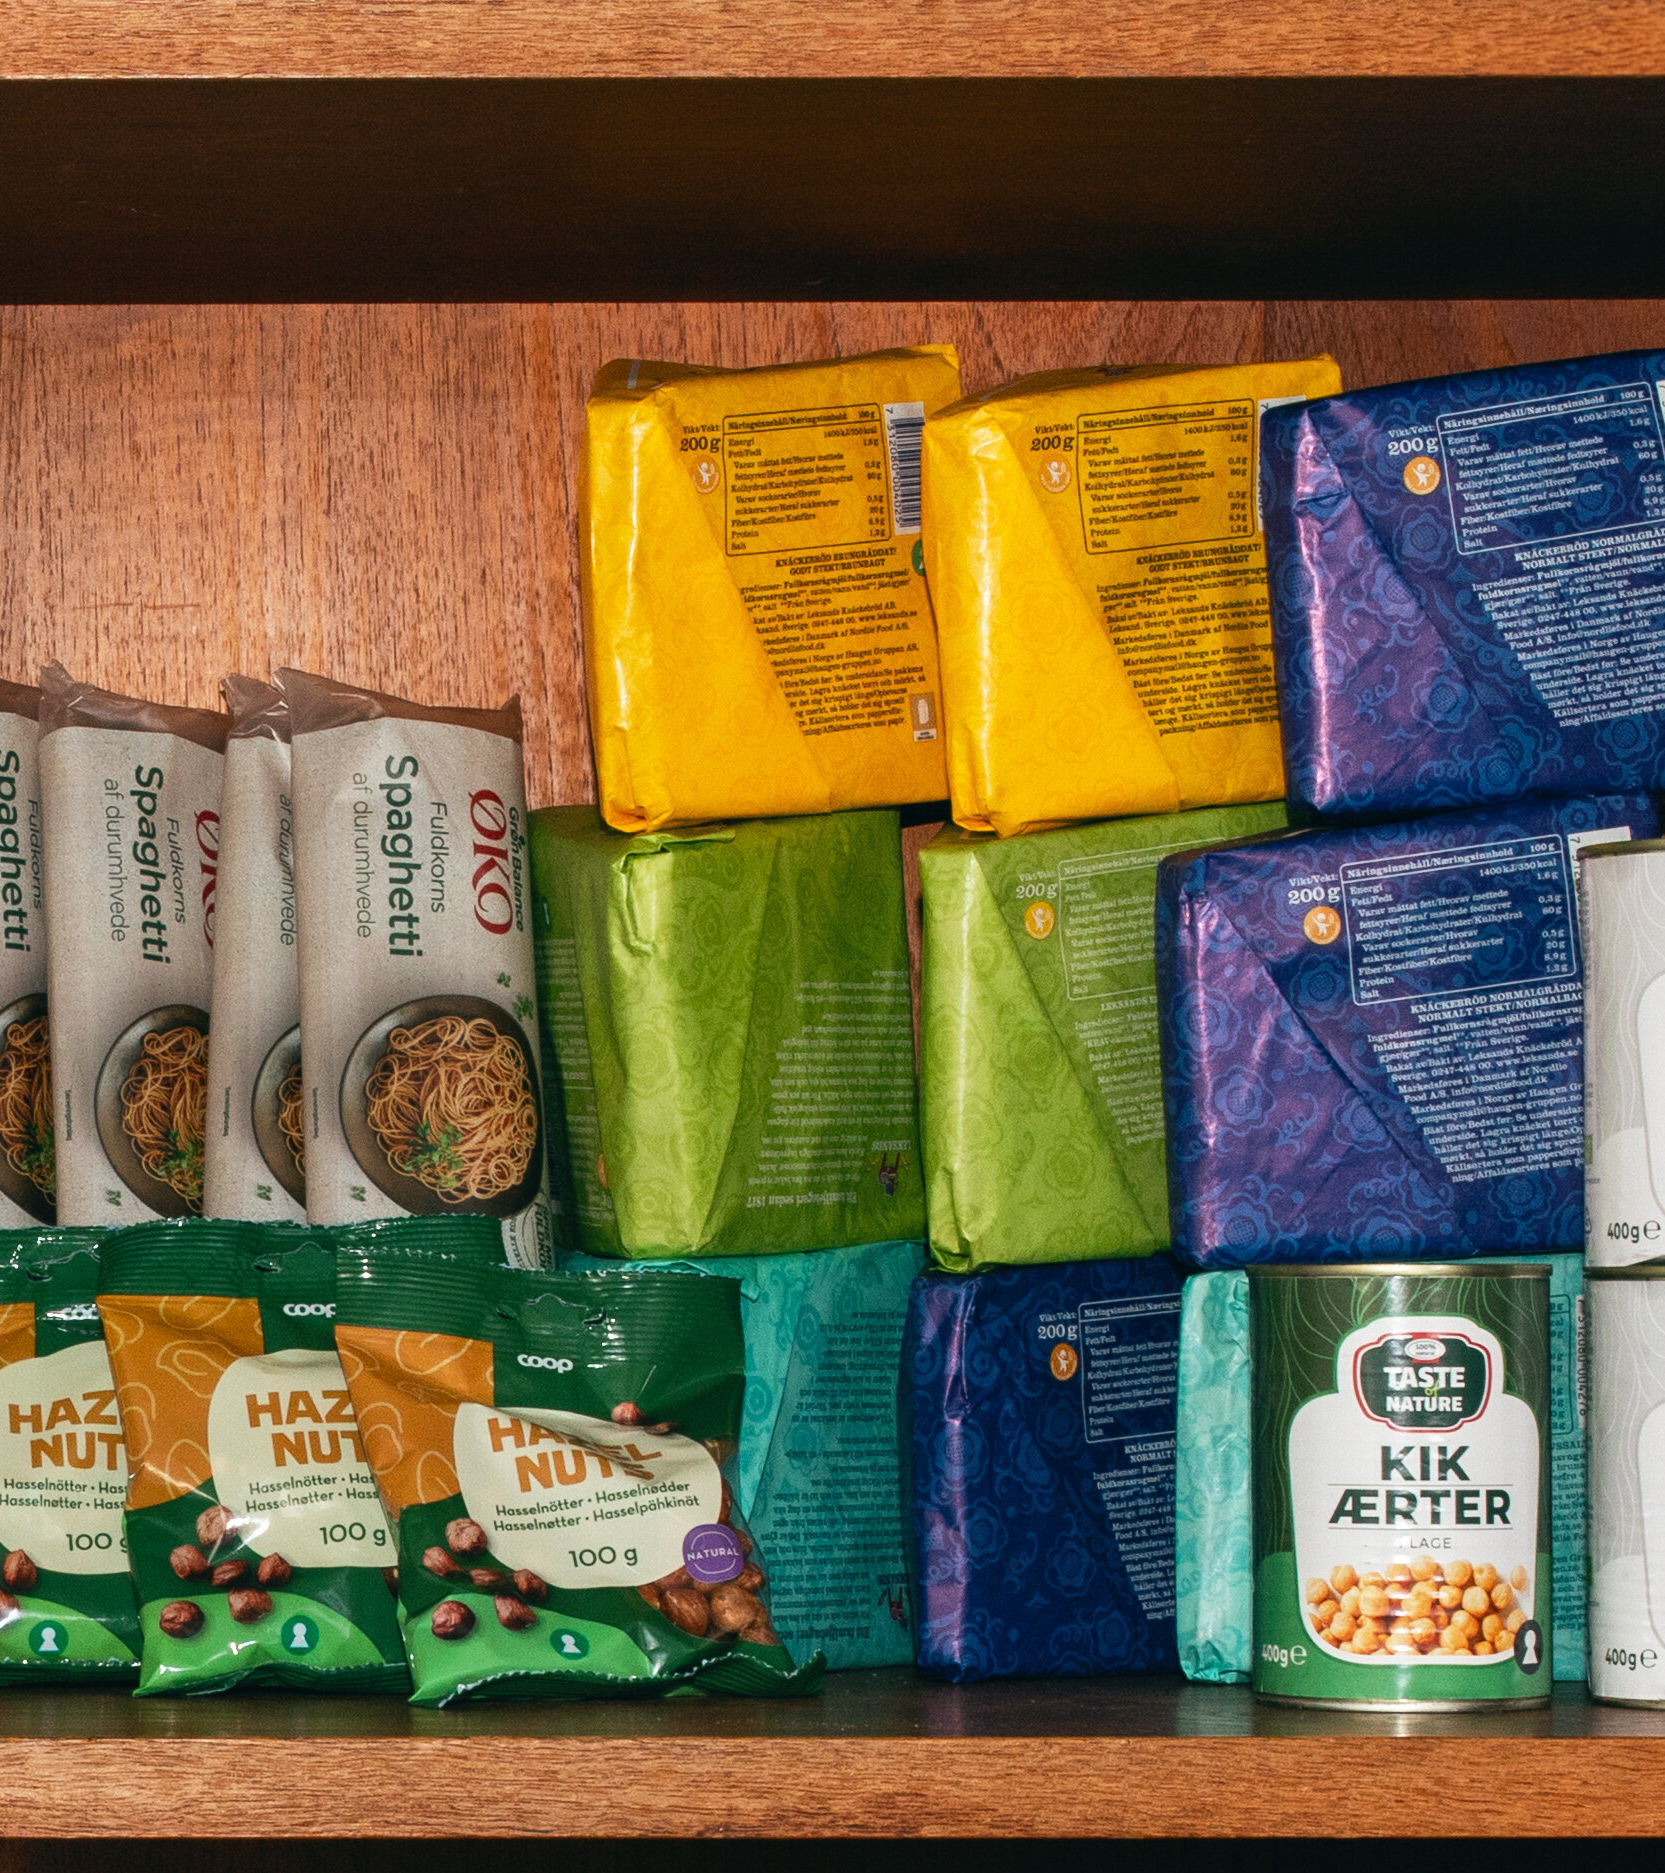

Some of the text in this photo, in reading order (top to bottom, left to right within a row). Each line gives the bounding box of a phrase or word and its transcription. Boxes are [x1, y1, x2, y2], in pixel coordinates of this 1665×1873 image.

[1444, 394, 1605, 429] Näringsinnehåll/Næringsinnhold
[680, 436, 710, 453] 200
[1030, 433, 1060, 453] 200
[1388, 437, 1424, 456] 200
[1447, 433, 1480, 447] Energi
[1449, 443, 1491, 457] Fett/Fedt
[1462, 524, 1498, 538] Protein
[1463, 538, 1483, 550] Salt
[1521, 553, 1577, 572] NORMALT
[1537, 607, 1580, 624] 0247-448
[1503, 623, 1569, 642] Markedsføres
[1576, 613, 1619, 630] Danmark
[1517, 643, 1583, 663] Markedsføres
[1589, 635, 1619, 652] Norge
[28, 799, 45, 910] Fuldkorns
[104, 778, 130, 943] af durumhvede
[130, 764, 171, 964] Spaghetti
[352, 772, 376, 939] af durumhvede
[379, 755, 423, 957] Spaghetti
[430, 801, 449, 914] Fuldkorns
[468, 789, 514, 936] ØKO
[1347, 847, 1514, 880] Näringsinnehåll/Næringsinnhold
[166, 817, 186, 924] Fuldkorns
[1288, 873, 1339, 888] Vikt/Vekt:
[511, 856, 525, 933] Balance
[1015, 883, 1044, 900] 200
[1288, 887, 1325, 905] 200
[1348, 883, 1383, 896] Energi
[1359, 975, 1395, 989] Protein
[1359, 989, 1380, 1001] Salt
[1607, 1222, 1640, 1244] 400g
[1037, 1324, 1066, 1341] 200
[517, 1354, 574, 1374] coop
[1383, 1366, 1466, 1391] TASTE
[1386, 1395, 1463, 1412] NATURE
[1381, 1445, 1471, 1482] KIK
[3, 1477, 87, 1493] Hasselnötter
[249, 1475, 337, 1496] Hasselnötter
[245, 1490, 334, 1513] Hasselnøtter
[496, 1481, 691, 1518] Hasselnötter Hasselnødder
[1328, 1488, 1512, 1525] ÆRTER
[493, 1496, 700, 1533] Hasselnøtter Hasselpähkinät
[66, 1532, 112, 1551] 100
[320, 1522, 386, 1547] 100 g
[1410, 1537, 1452, 1549] LAGE
[568, 1546, 639, 1571] 100 g
[686, 1547, 740, 1561] NATURAL
[1605, 1648, 1637, 1670] 400g
